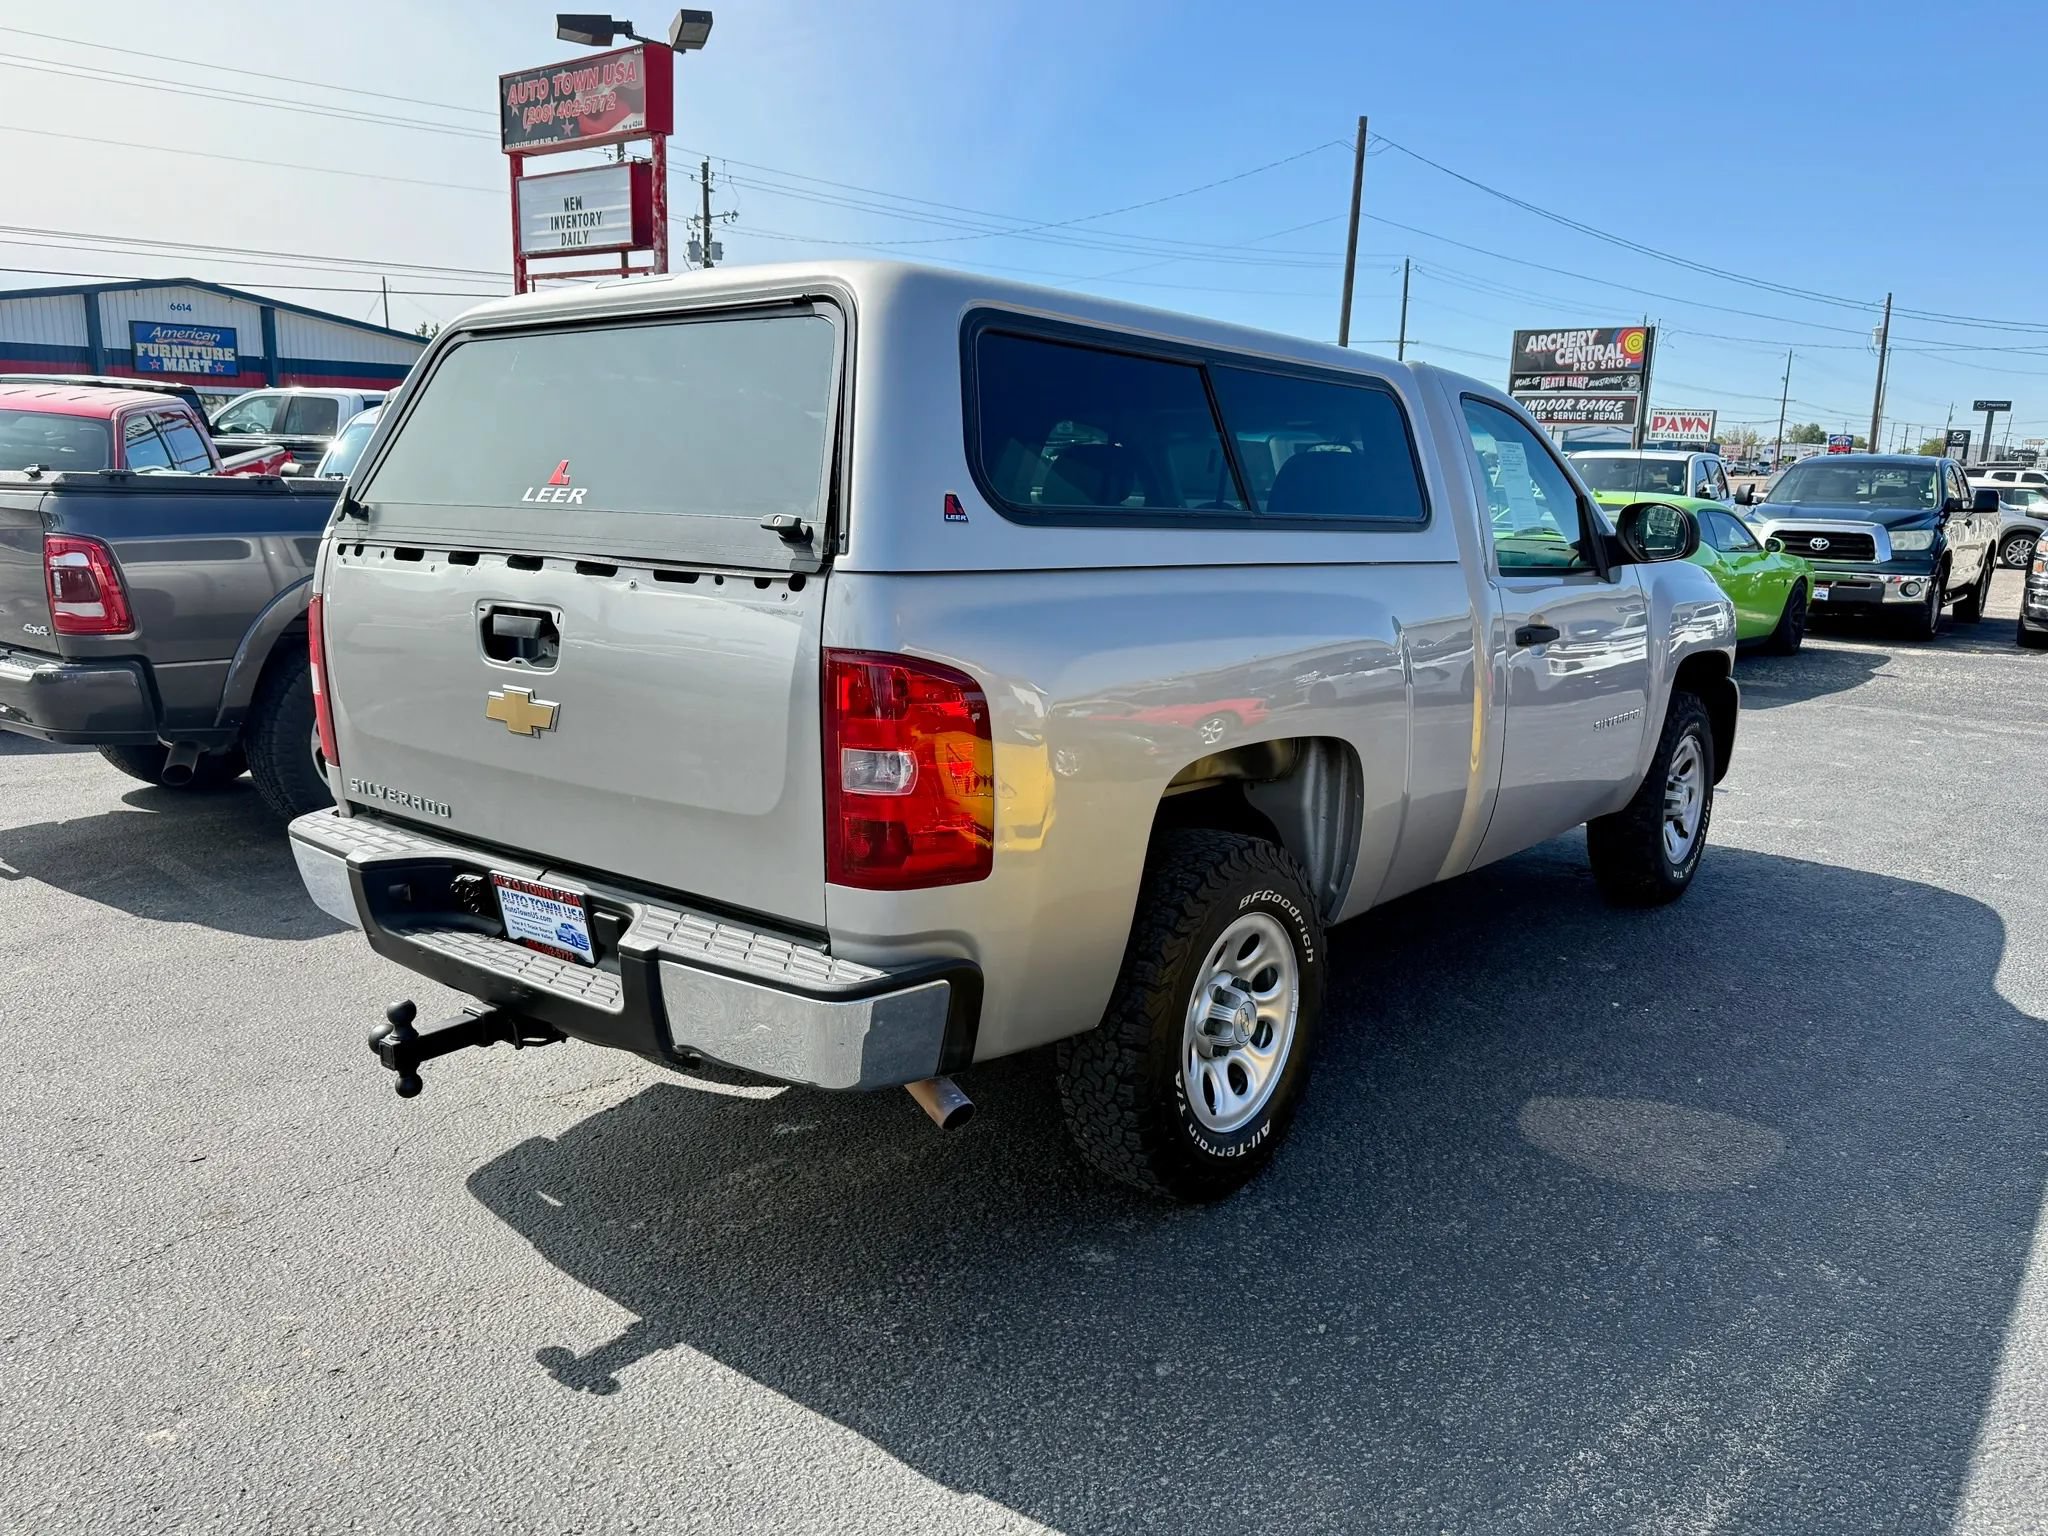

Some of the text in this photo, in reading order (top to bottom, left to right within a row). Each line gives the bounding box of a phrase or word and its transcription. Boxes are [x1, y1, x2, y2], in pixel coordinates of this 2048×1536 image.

[507, 60, 637, 105] AUTO TOWN USA
[523, 91, 616, 129] (208) 402-5772
[563, 196, 583, 211] NEW
[550, 211, 602, 230] INVENTORY
[561, 230, 589, 247] DAILY
[169, 302, 192, 313] 6614
[149, 327, 220, 341] American
[1525, 329, 1599, 353] ARCHERY
[136, 342, 235, 362] FURNITURE
[1555, 342, 1624, 365] CENTRAL
[163, 358, 213, 374] MART
[1573, 358, 1632, 372] PRO SHOP
[1540, 376, 1565, 390] DEATH
[1566, 376, 1589, 390] HARP
[1523, 399, 1626, 412] INDOOR RANGE
[1553, 411, 1587, 420] SERVICE
[1593, 411, 1624, 421] REPAIR
[1651, 416, 1711, 433] PAWN
[521, 486, 588, 504] LEER
[350, 778, 452, 818] SILVERADO
[493, 874, 580, 906] AUTO TOWN USA
[501, 890, 586, 923] AUTO TOWN USA
[1238, 888, 1314, 963] BFGoodrich
[1175, 1069, 1271, 1158] All-Terrain T/A
